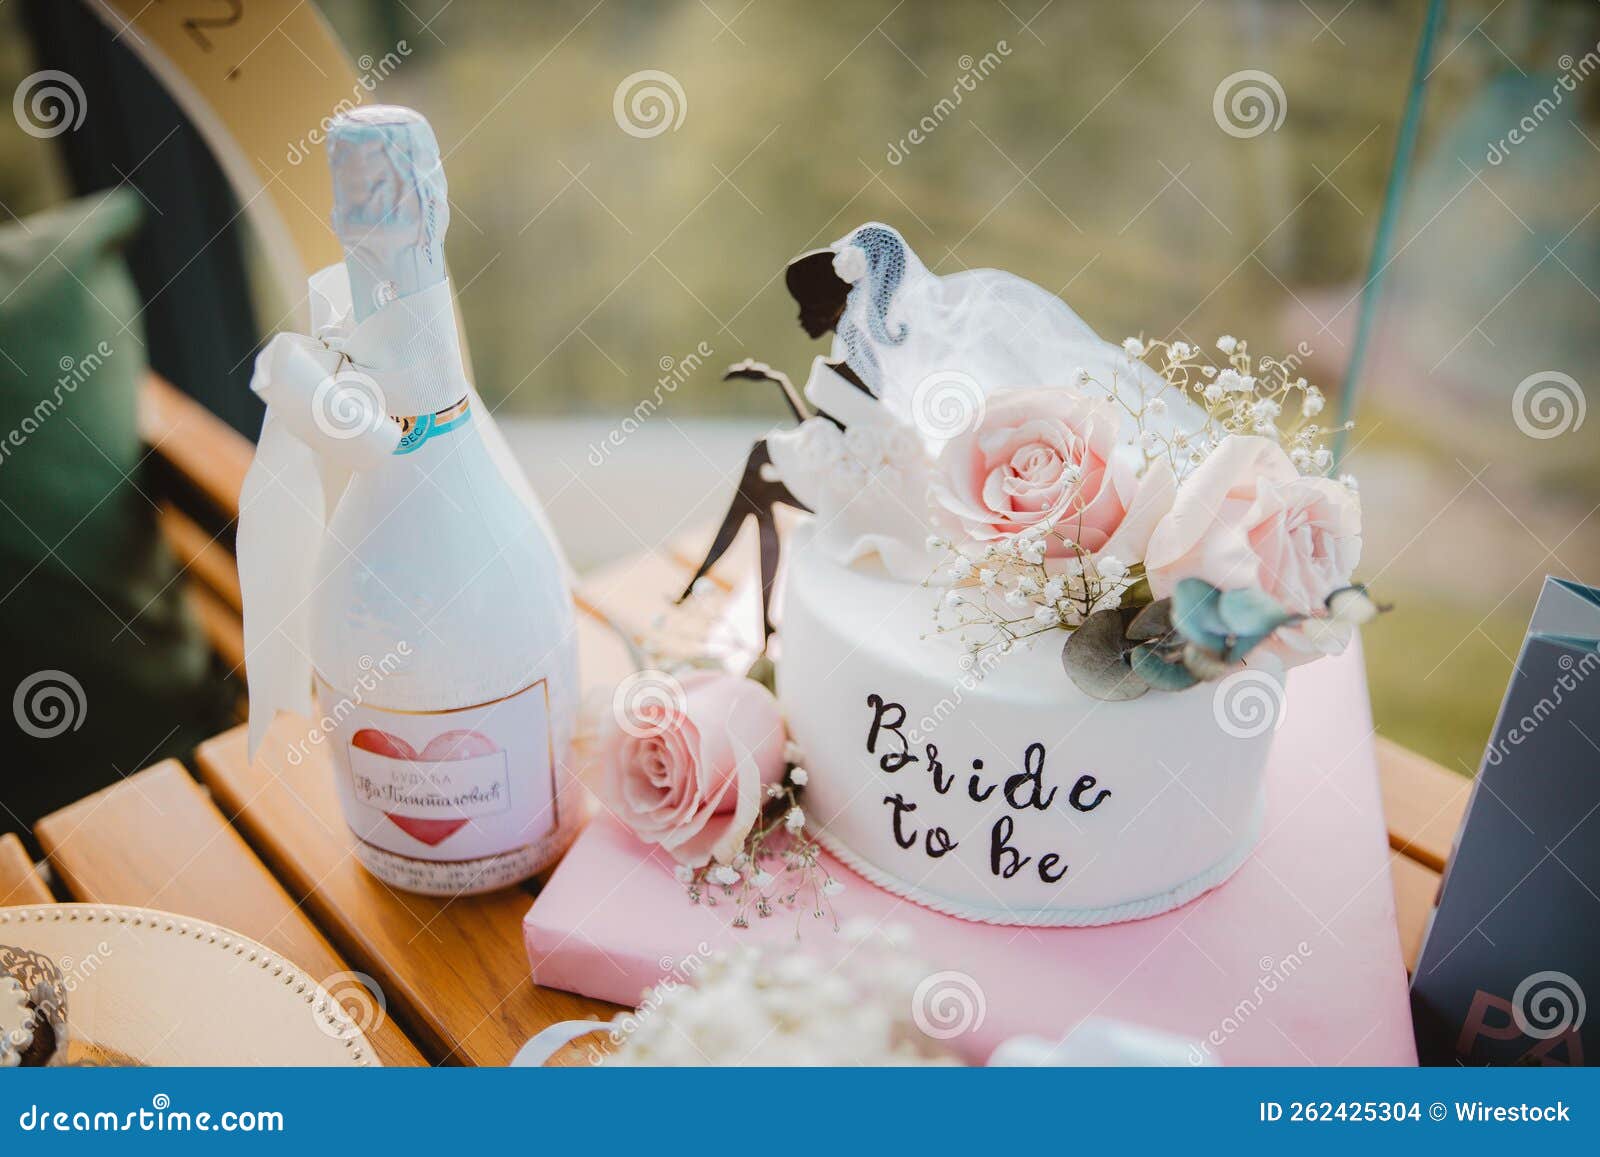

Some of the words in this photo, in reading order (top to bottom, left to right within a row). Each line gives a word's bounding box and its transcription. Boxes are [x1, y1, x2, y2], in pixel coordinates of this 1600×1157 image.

[867, 693, 1112, 812] Bride
[883, 794, 959, 858] to
[991, 815, 1068, 883] be
